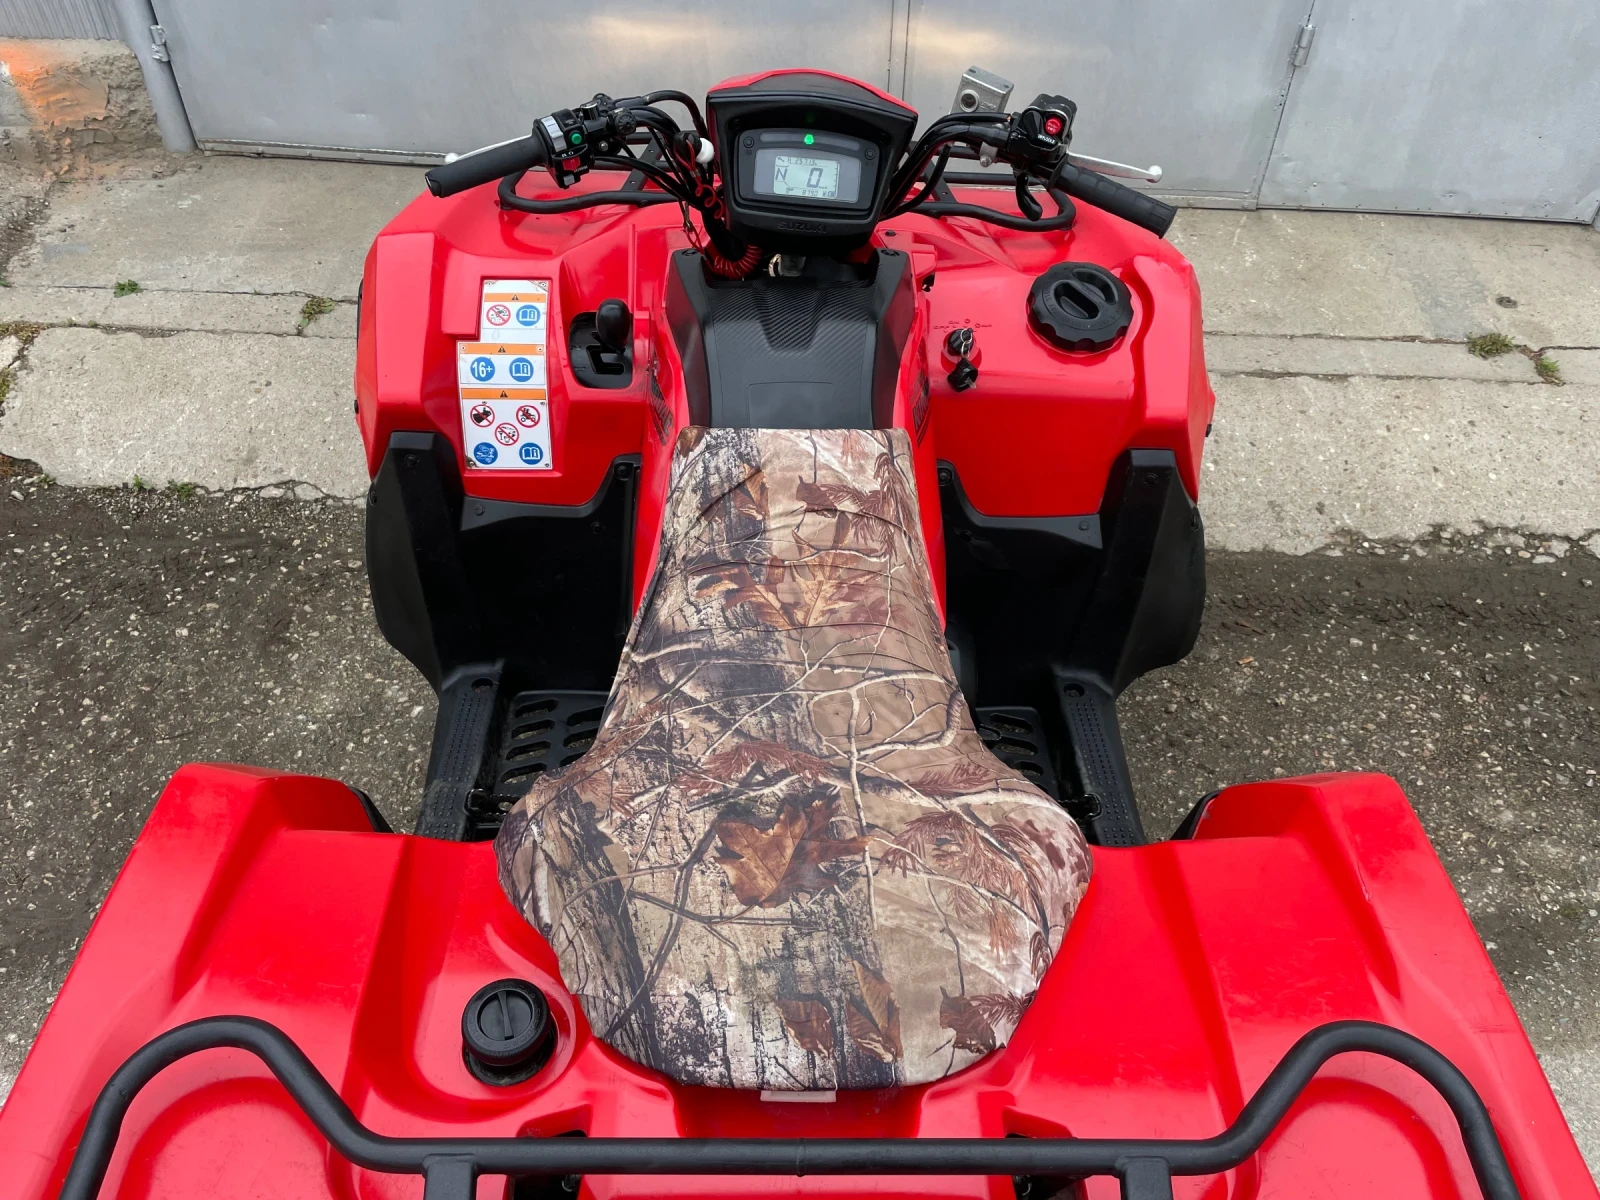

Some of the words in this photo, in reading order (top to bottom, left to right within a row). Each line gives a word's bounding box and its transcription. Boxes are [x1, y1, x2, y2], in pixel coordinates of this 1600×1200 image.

[775, 167, 788, 181] N
[807, 168, 823, 188] 0
[777, 220, 827, 233] SUZUKI
[472, 361, 493, 378] 16+
